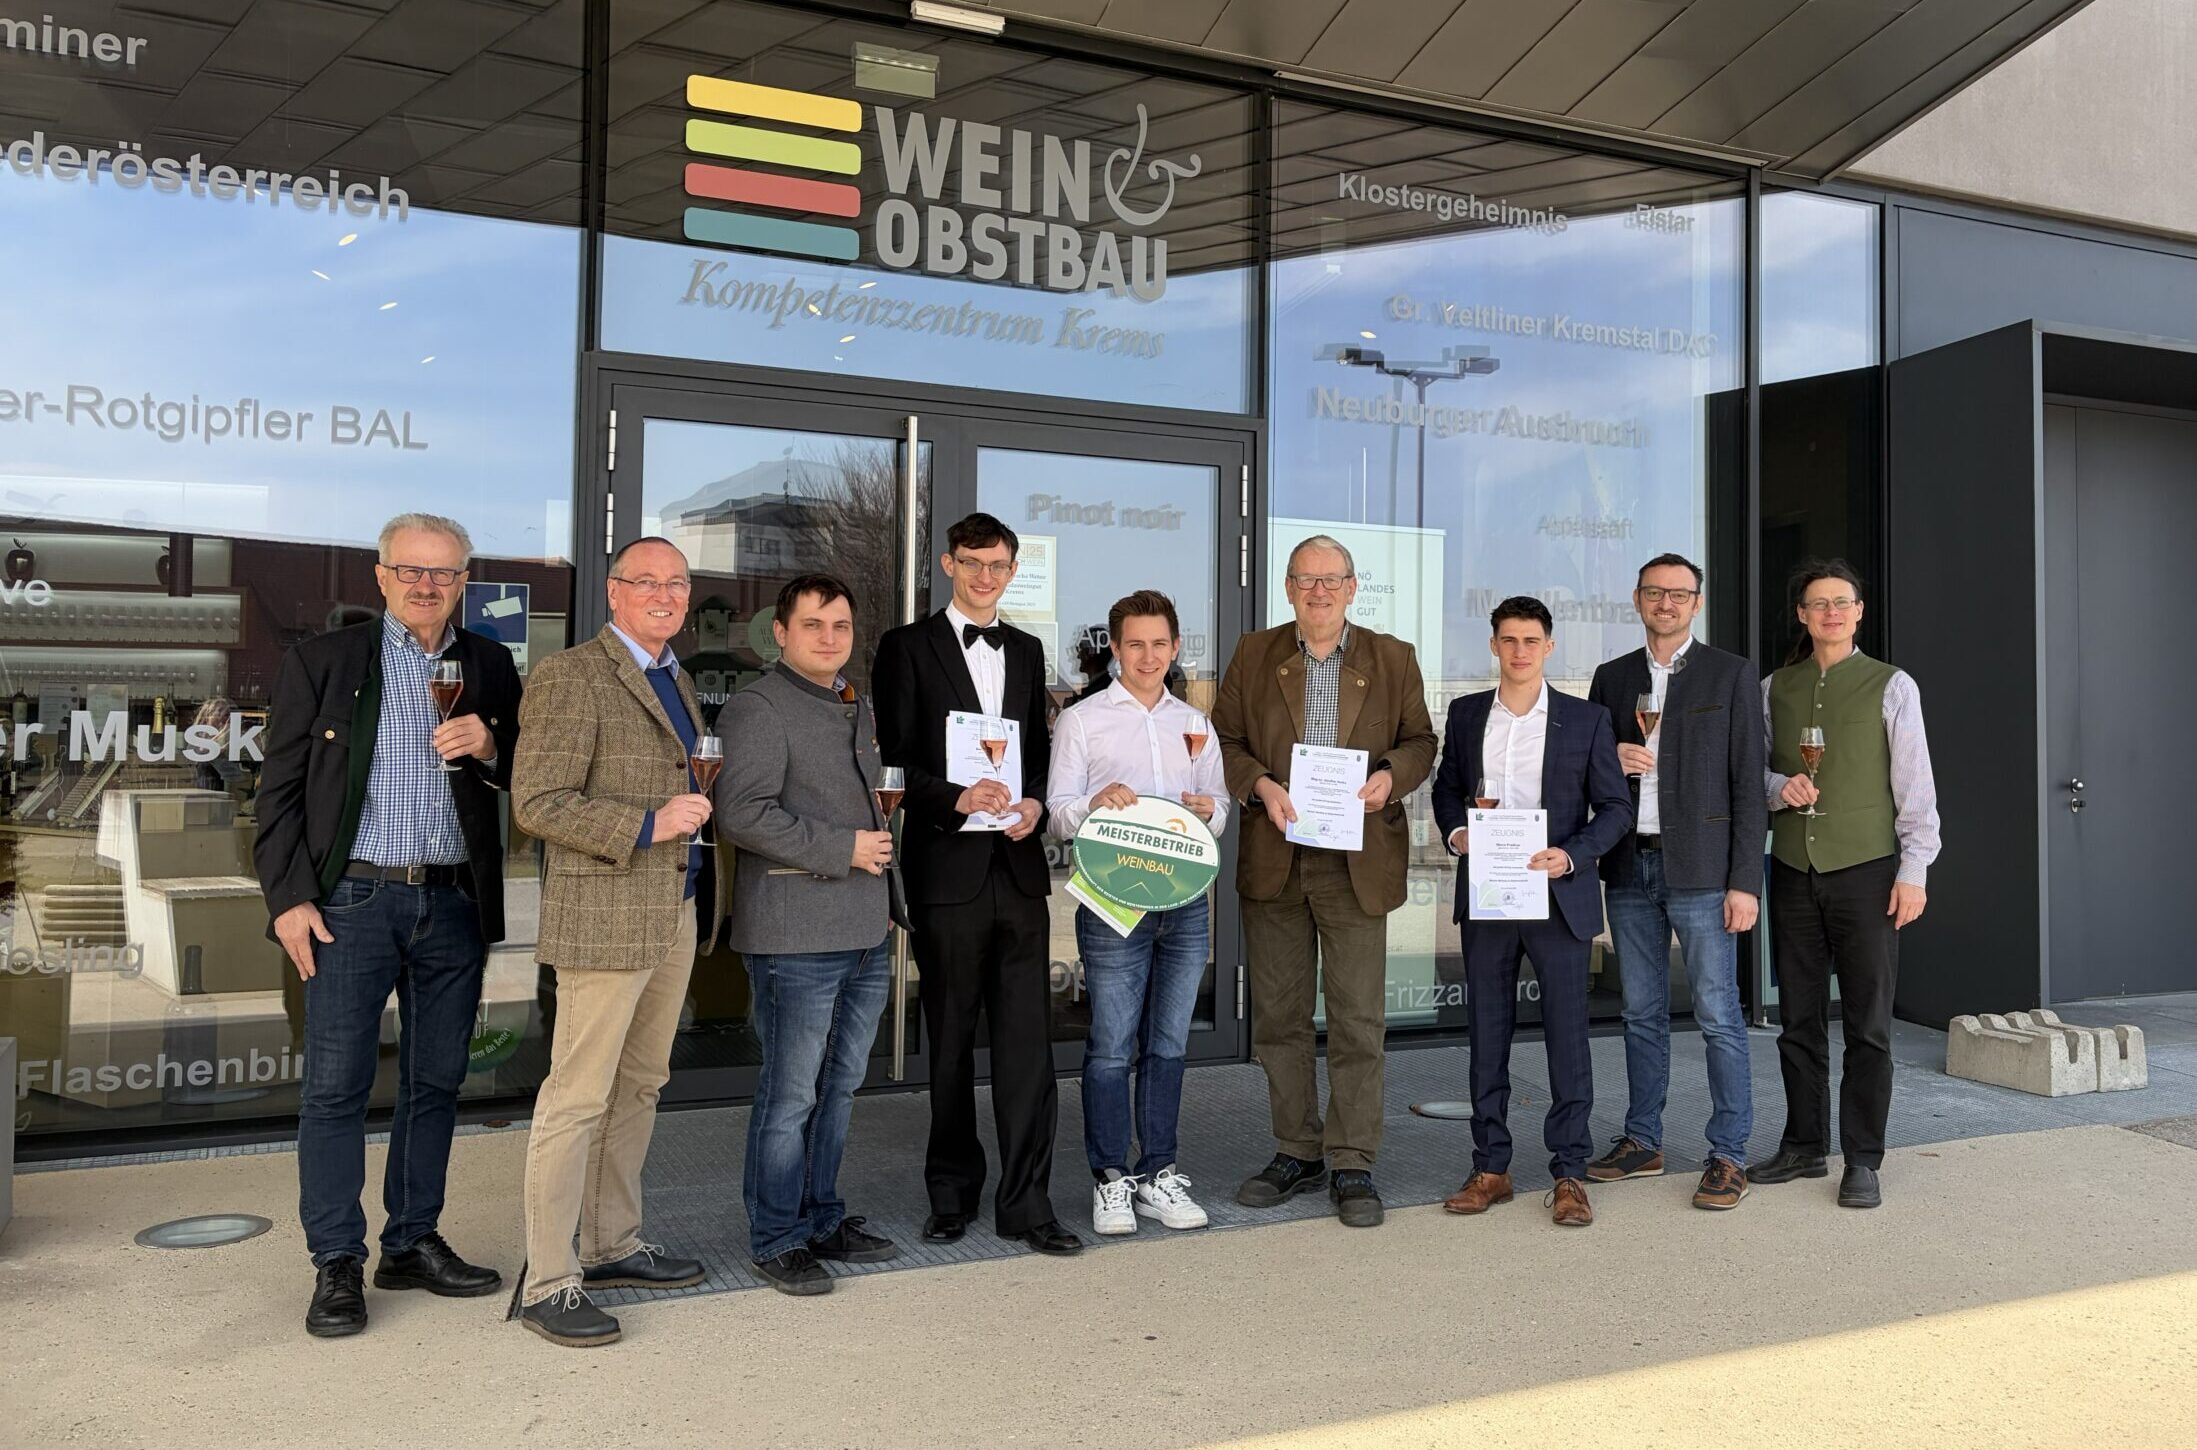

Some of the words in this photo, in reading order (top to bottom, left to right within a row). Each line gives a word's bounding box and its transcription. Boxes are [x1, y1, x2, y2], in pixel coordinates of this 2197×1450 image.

[0, 15, 148, 65] miner
[0, 130, 409, 220] derösterreich
[875, 105, 1090, 223] WEIN
[1103, 102, 1201, 226] &
[1339, 172, 1569, 235] Klostergeheimnis
[875, 198, 1167, 301] OBSTBAU
[680, 258, 1044, 347] Kompetenzzentrum
[1052, 305, 1165, 360] Krems
[1440, 299, 1546, 337] Veltliner
[1553, 313, 1660, 349] Kremstal
[331, 405, 429, 450] BAL
[1312, 385, 1493, 438] Neuburger
[1027, 493, 1115, 526] Pinot
[1120, 503, 1186, 531] noir
[1356, 607, 1377, 616] GUT
[1357, 584, 1395, 594] LANDES
[1357, 596, 1382, 605] WEIN
[0, 722, 44, 761] r
[69, 710, 265, 762] Musk
[1097, 824, 1204, 857] MEISTERBETRIEB
[1117, 853, 1175, 876] WEINBAU
[1385, 979, 1468, 1009] Frizza
